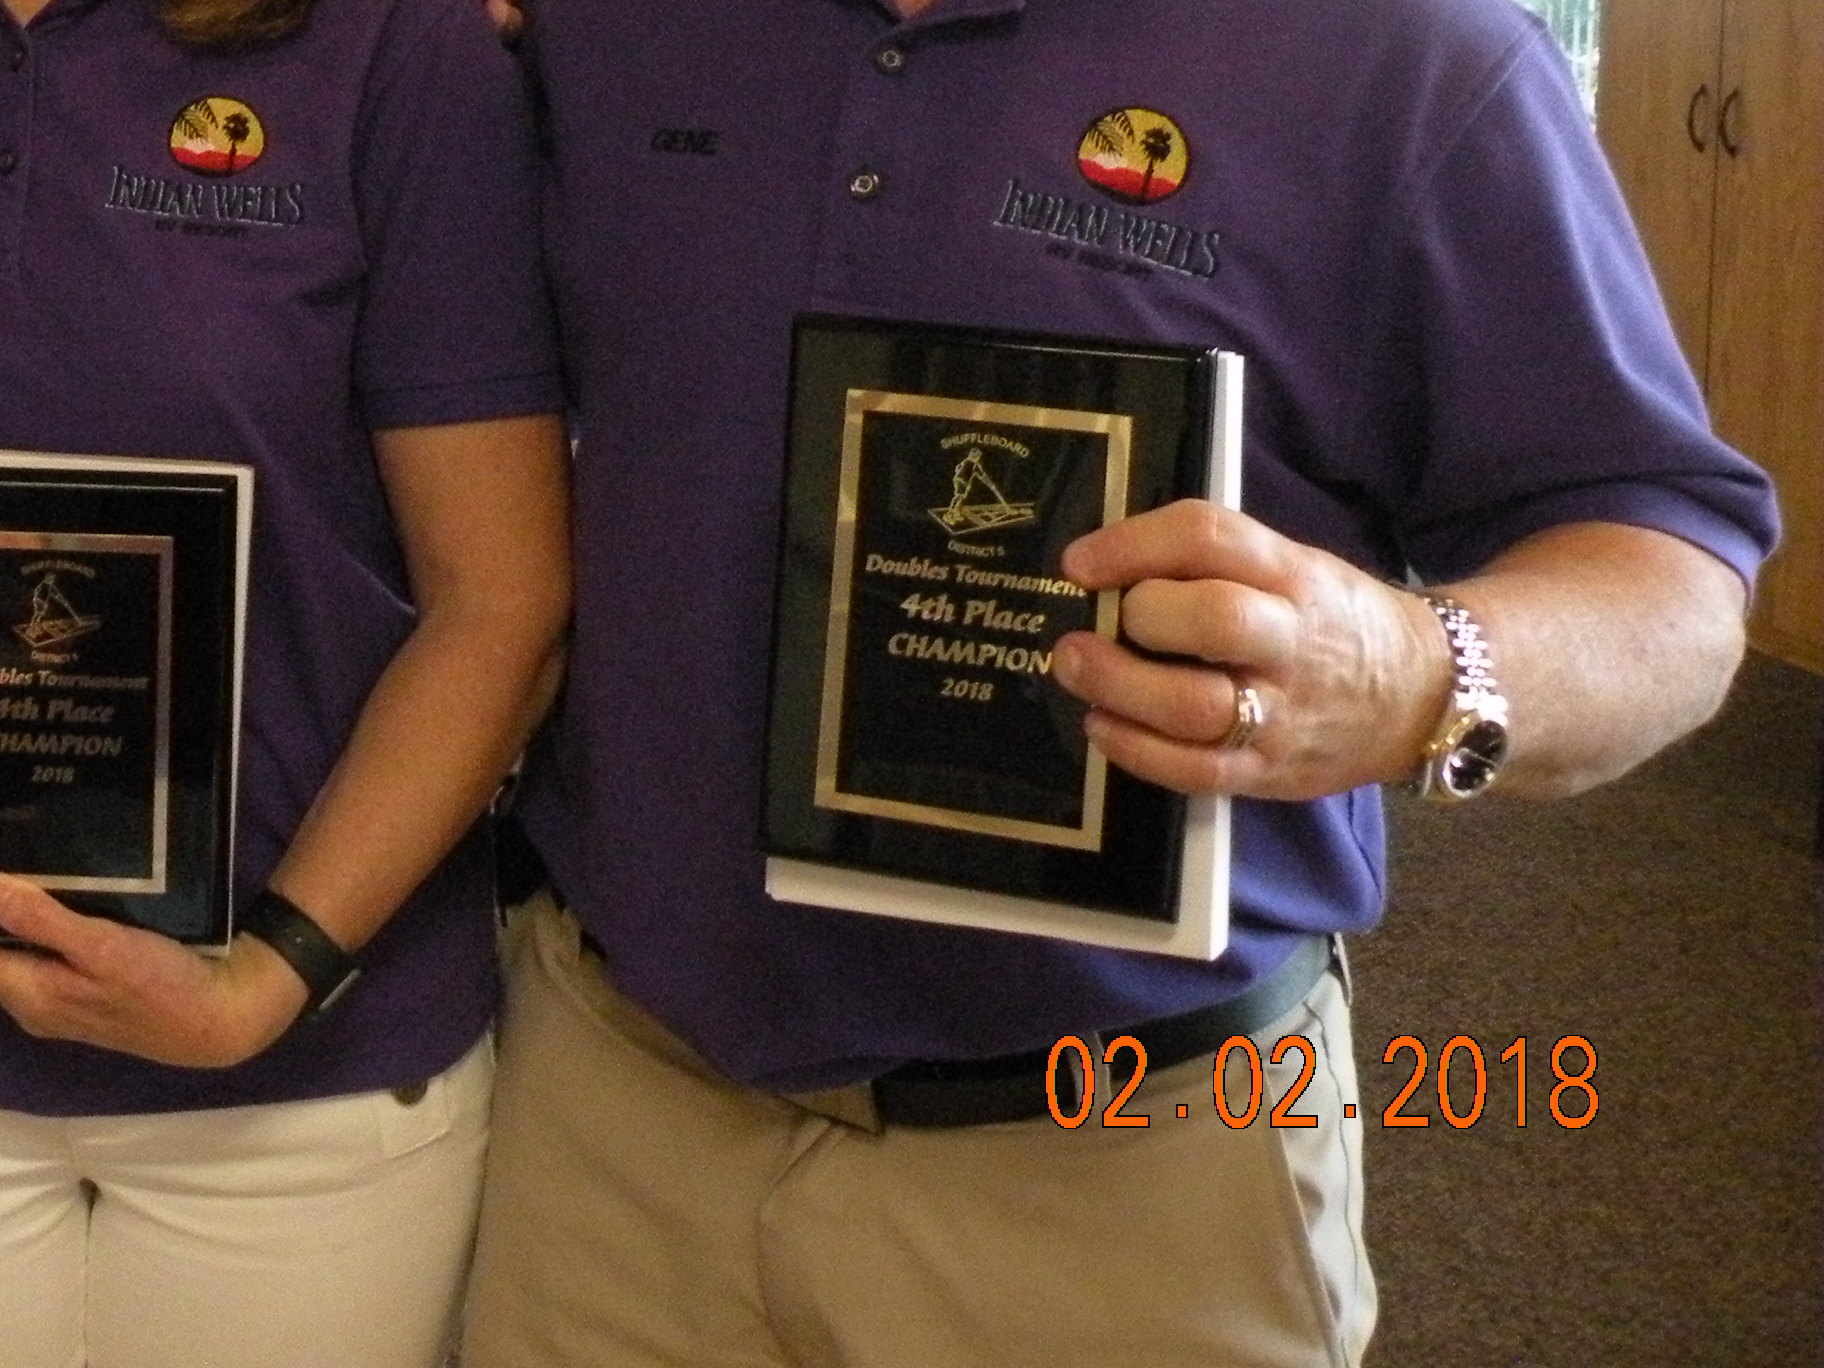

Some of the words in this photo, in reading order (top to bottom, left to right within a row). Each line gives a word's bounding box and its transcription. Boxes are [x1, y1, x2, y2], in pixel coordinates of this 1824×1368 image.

[650, 128, 719, 156] GENE
[104, 165, 206, 219] INDIAN
[211, 183, 305, 226] WELLS
[992, 178, 1110, 250] INDIAN
[1117, 212, 1220, 282] WELLS
[940, 433, 1030, 458] SHUFFLEBOARD
[866, 554, 949, 581] Doubles
[899, 593, 955, 624] 4th
[963, 599, 1046, 634] Place
[888, 632, 1053, 676] CHAMPION
[940, 678, 994, 702] 2018
[46, 699, 115, 724] Place
[31, 766, 74, 783] 2018
